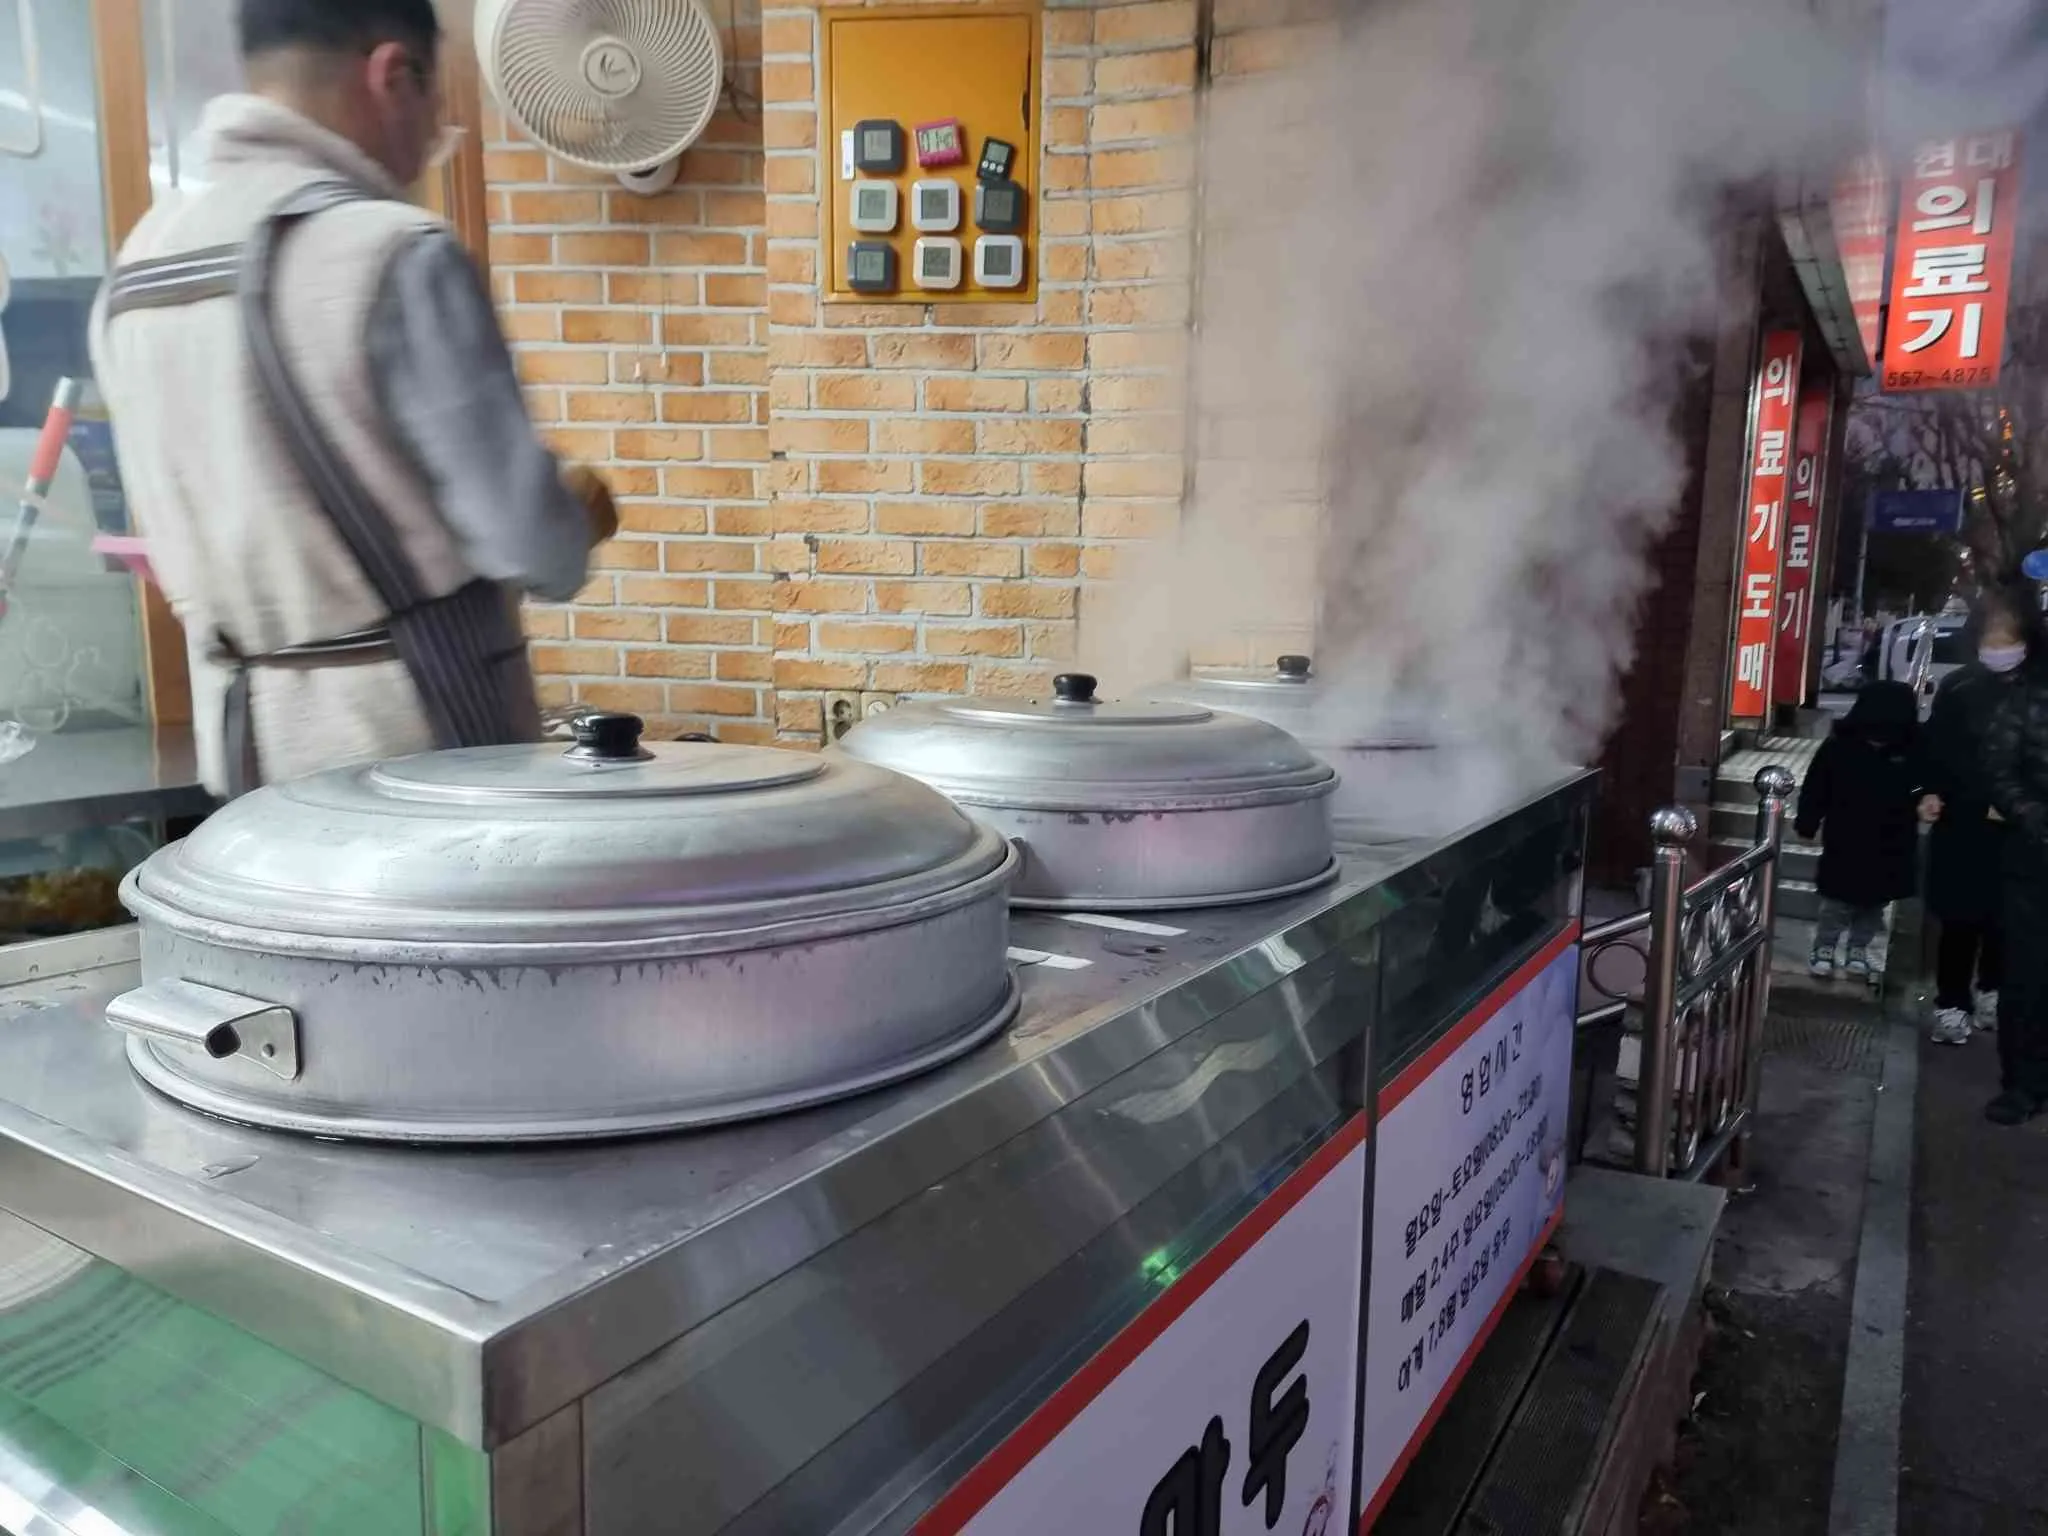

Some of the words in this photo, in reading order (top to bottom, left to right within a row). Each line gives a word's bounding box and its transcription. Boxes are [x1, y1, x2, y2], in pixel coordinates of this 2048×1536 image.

[1914, 131, 2015, 178] 현대
[1899, 178, 1997, 359] 의료기
[1780, 453, 1818, 640] 의료기
